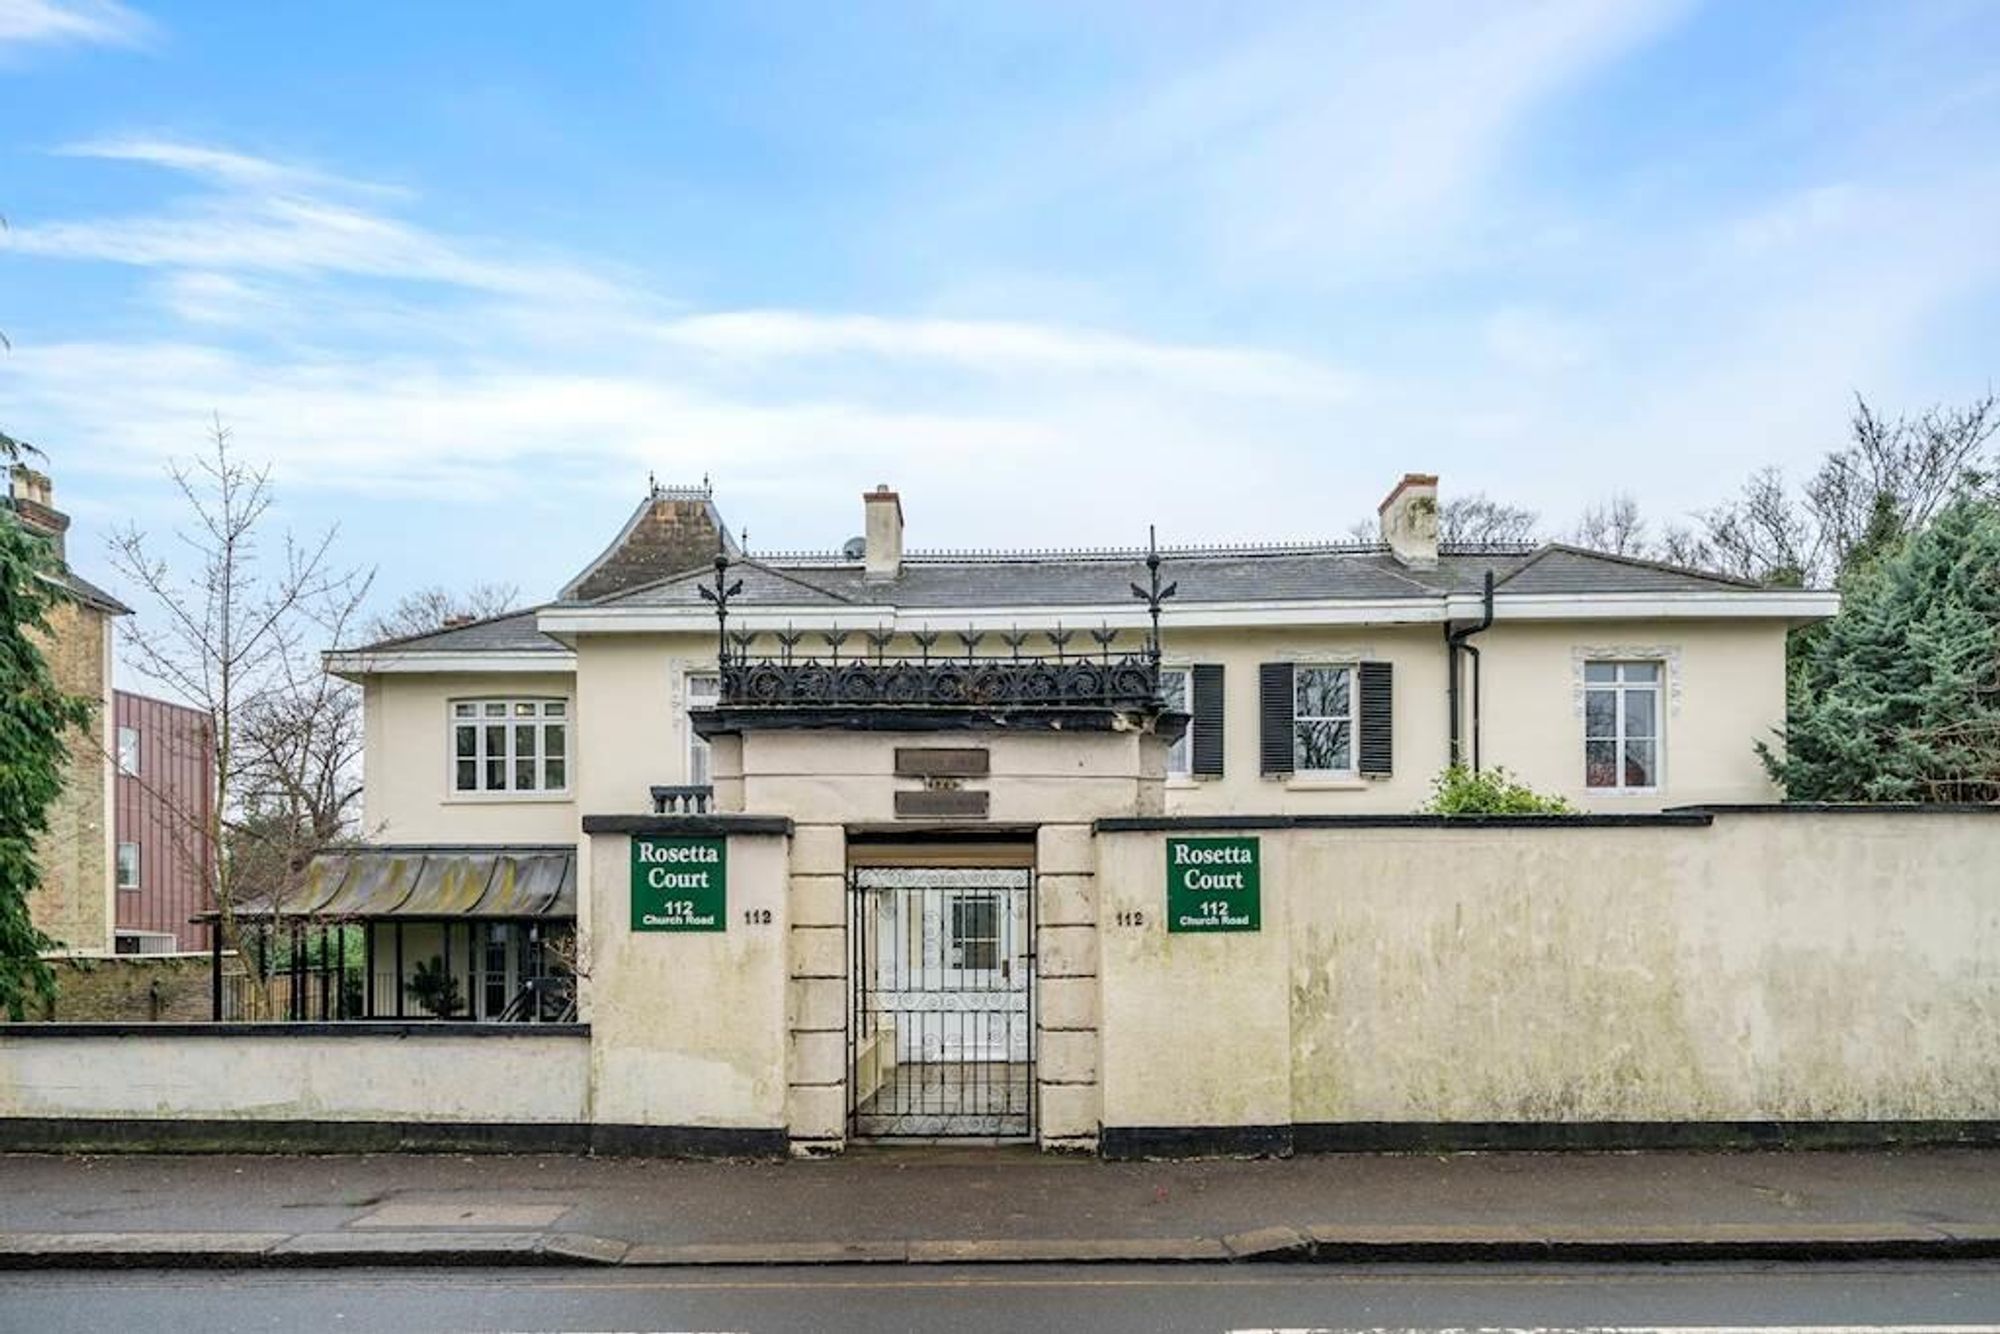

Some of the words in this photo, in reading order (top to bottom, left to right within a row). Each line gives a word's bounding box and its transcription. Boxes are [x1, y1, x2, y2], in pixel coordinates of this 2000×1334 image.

[638, 842, 719, 862] Rosetta
[1174, 844, 1252, 864] Rosetta
[648, 868, 709, 888] Court
[1184, 869, 1244, 889] Court
[664, 901, 694, 915] 112
[1200, 902, 1230, 915] 112
[642, 915, 683, 925] Church
[686, 915, 715, 925] Road
[744, 910, 772, 925] 112
[1116, 911, 1144, 926] 112
[1179, 915, 1219, 926] Church
[1221, 915, 1249, 926] Road
